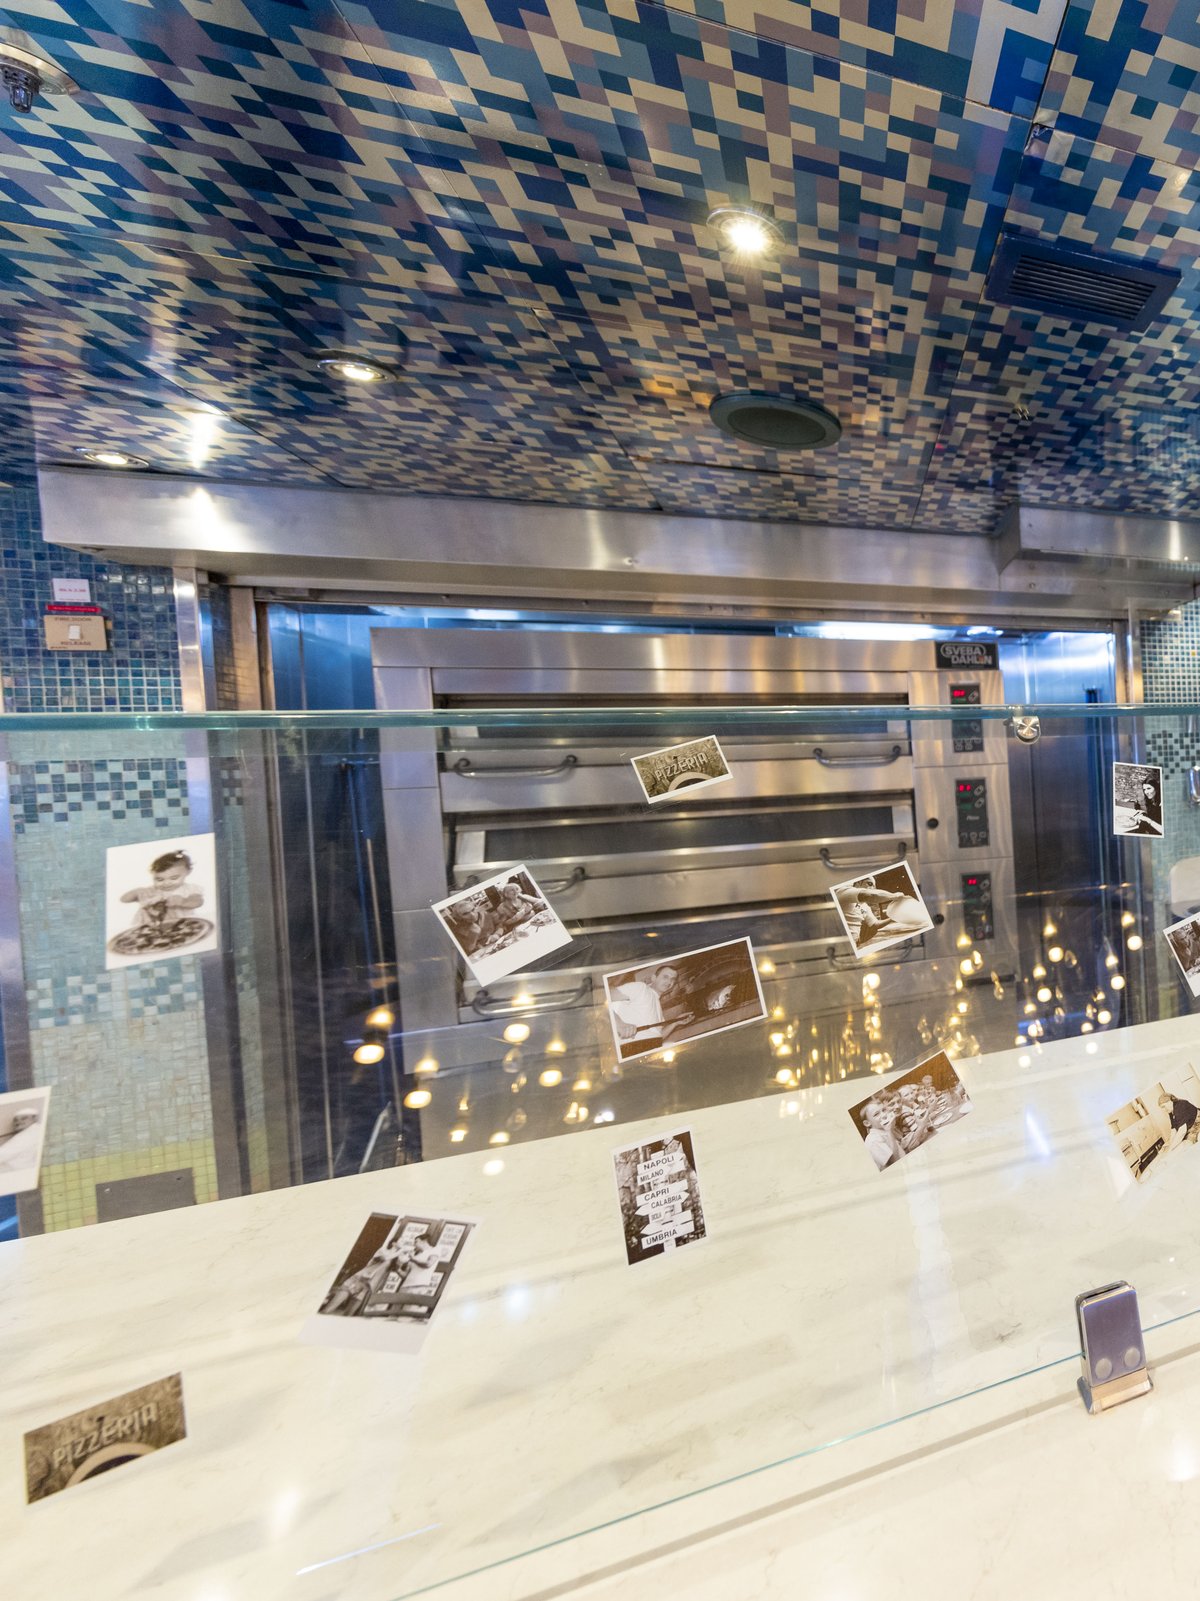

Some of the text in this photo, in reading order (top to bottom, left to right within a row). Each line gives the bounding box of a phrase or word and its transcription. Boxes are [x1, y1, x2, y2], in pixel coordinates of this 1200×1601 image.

[944, 646, 982, 655] SVEBA
[655, 753, 708, 781] PIZZERIA
[643, 1155, 675, 1170] NAPOLI
[640, 1168, 664, 1182] MILANO
[644, 1187, 670, 1202] CAPRI
[651, 1194, 682, 1209] CALABRIA
[646, 1228, 678, 1246] UMBRIA
[53, 1402, 158, 1469] PIZZERIA
